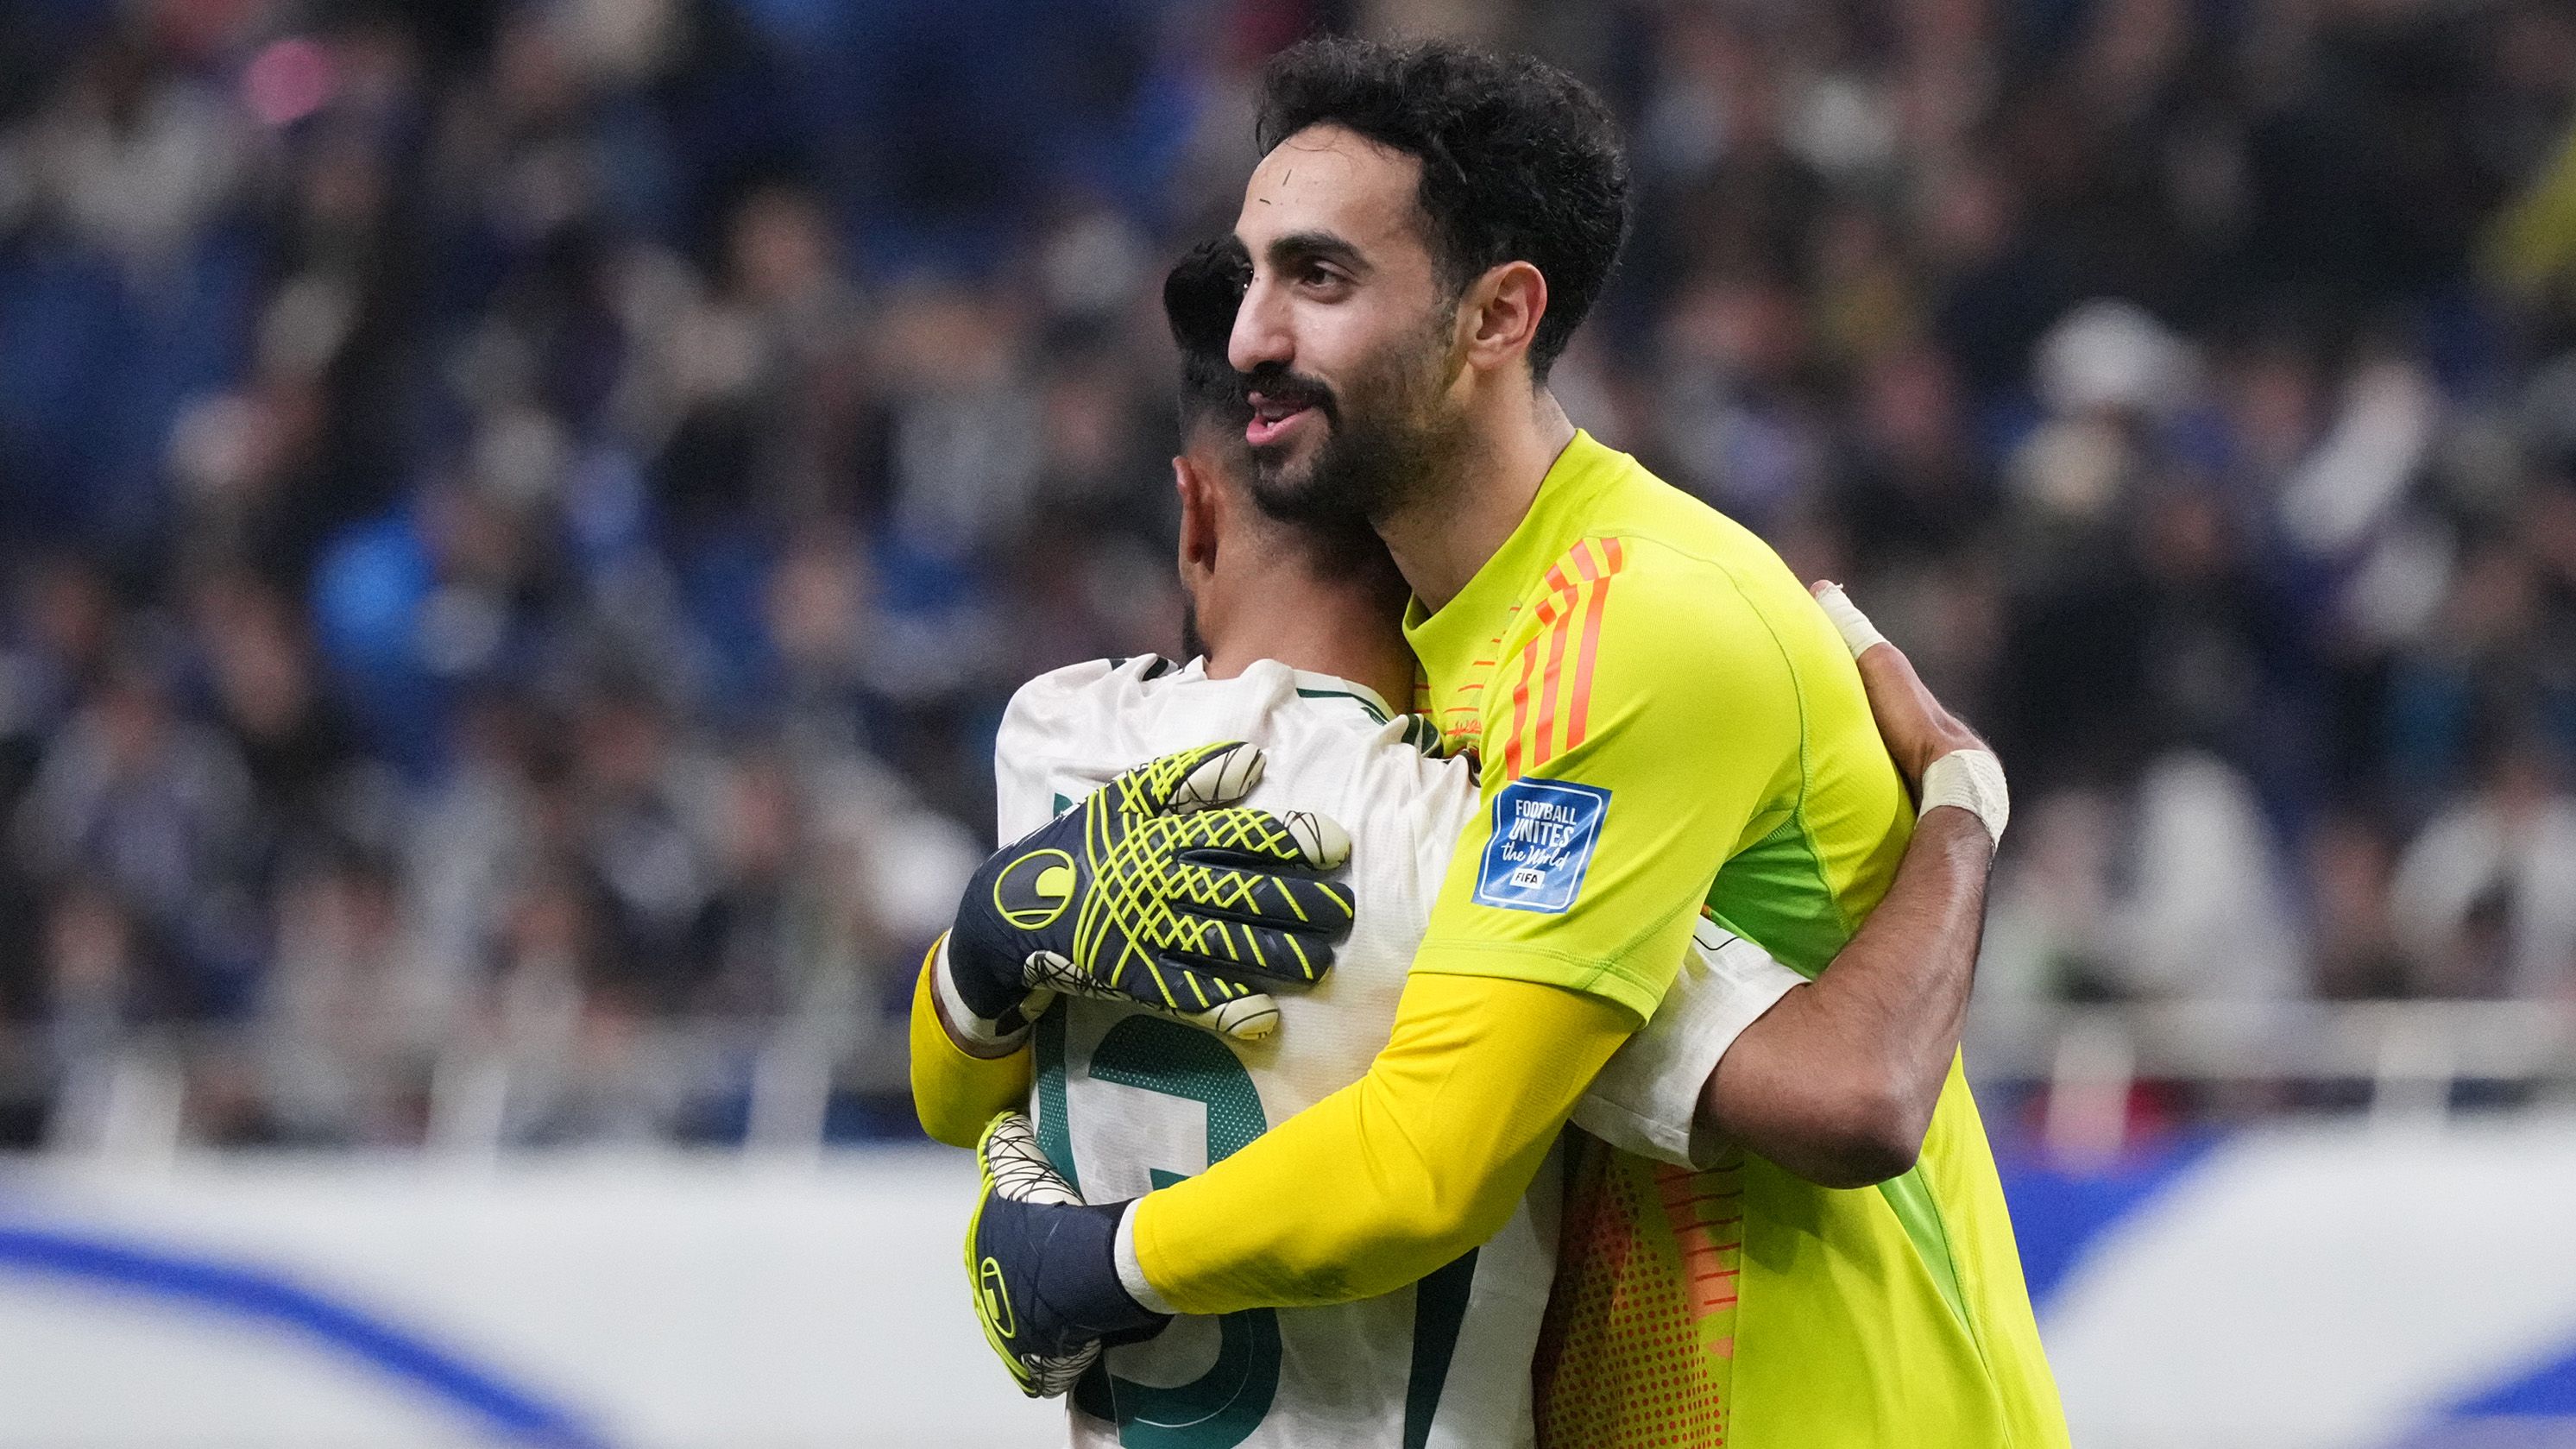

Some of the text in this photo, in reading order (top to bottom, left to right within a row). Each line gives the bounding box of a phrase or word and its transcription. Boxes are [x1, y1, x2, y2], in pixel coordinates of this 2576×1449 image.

[1515, 799, 1577, 825] FOOTBALL
[1508, 817, 1575, 848] UNITES
[1501, 841, 1571, 871] the World
[1515, 873, 1539, 885] FIFA
